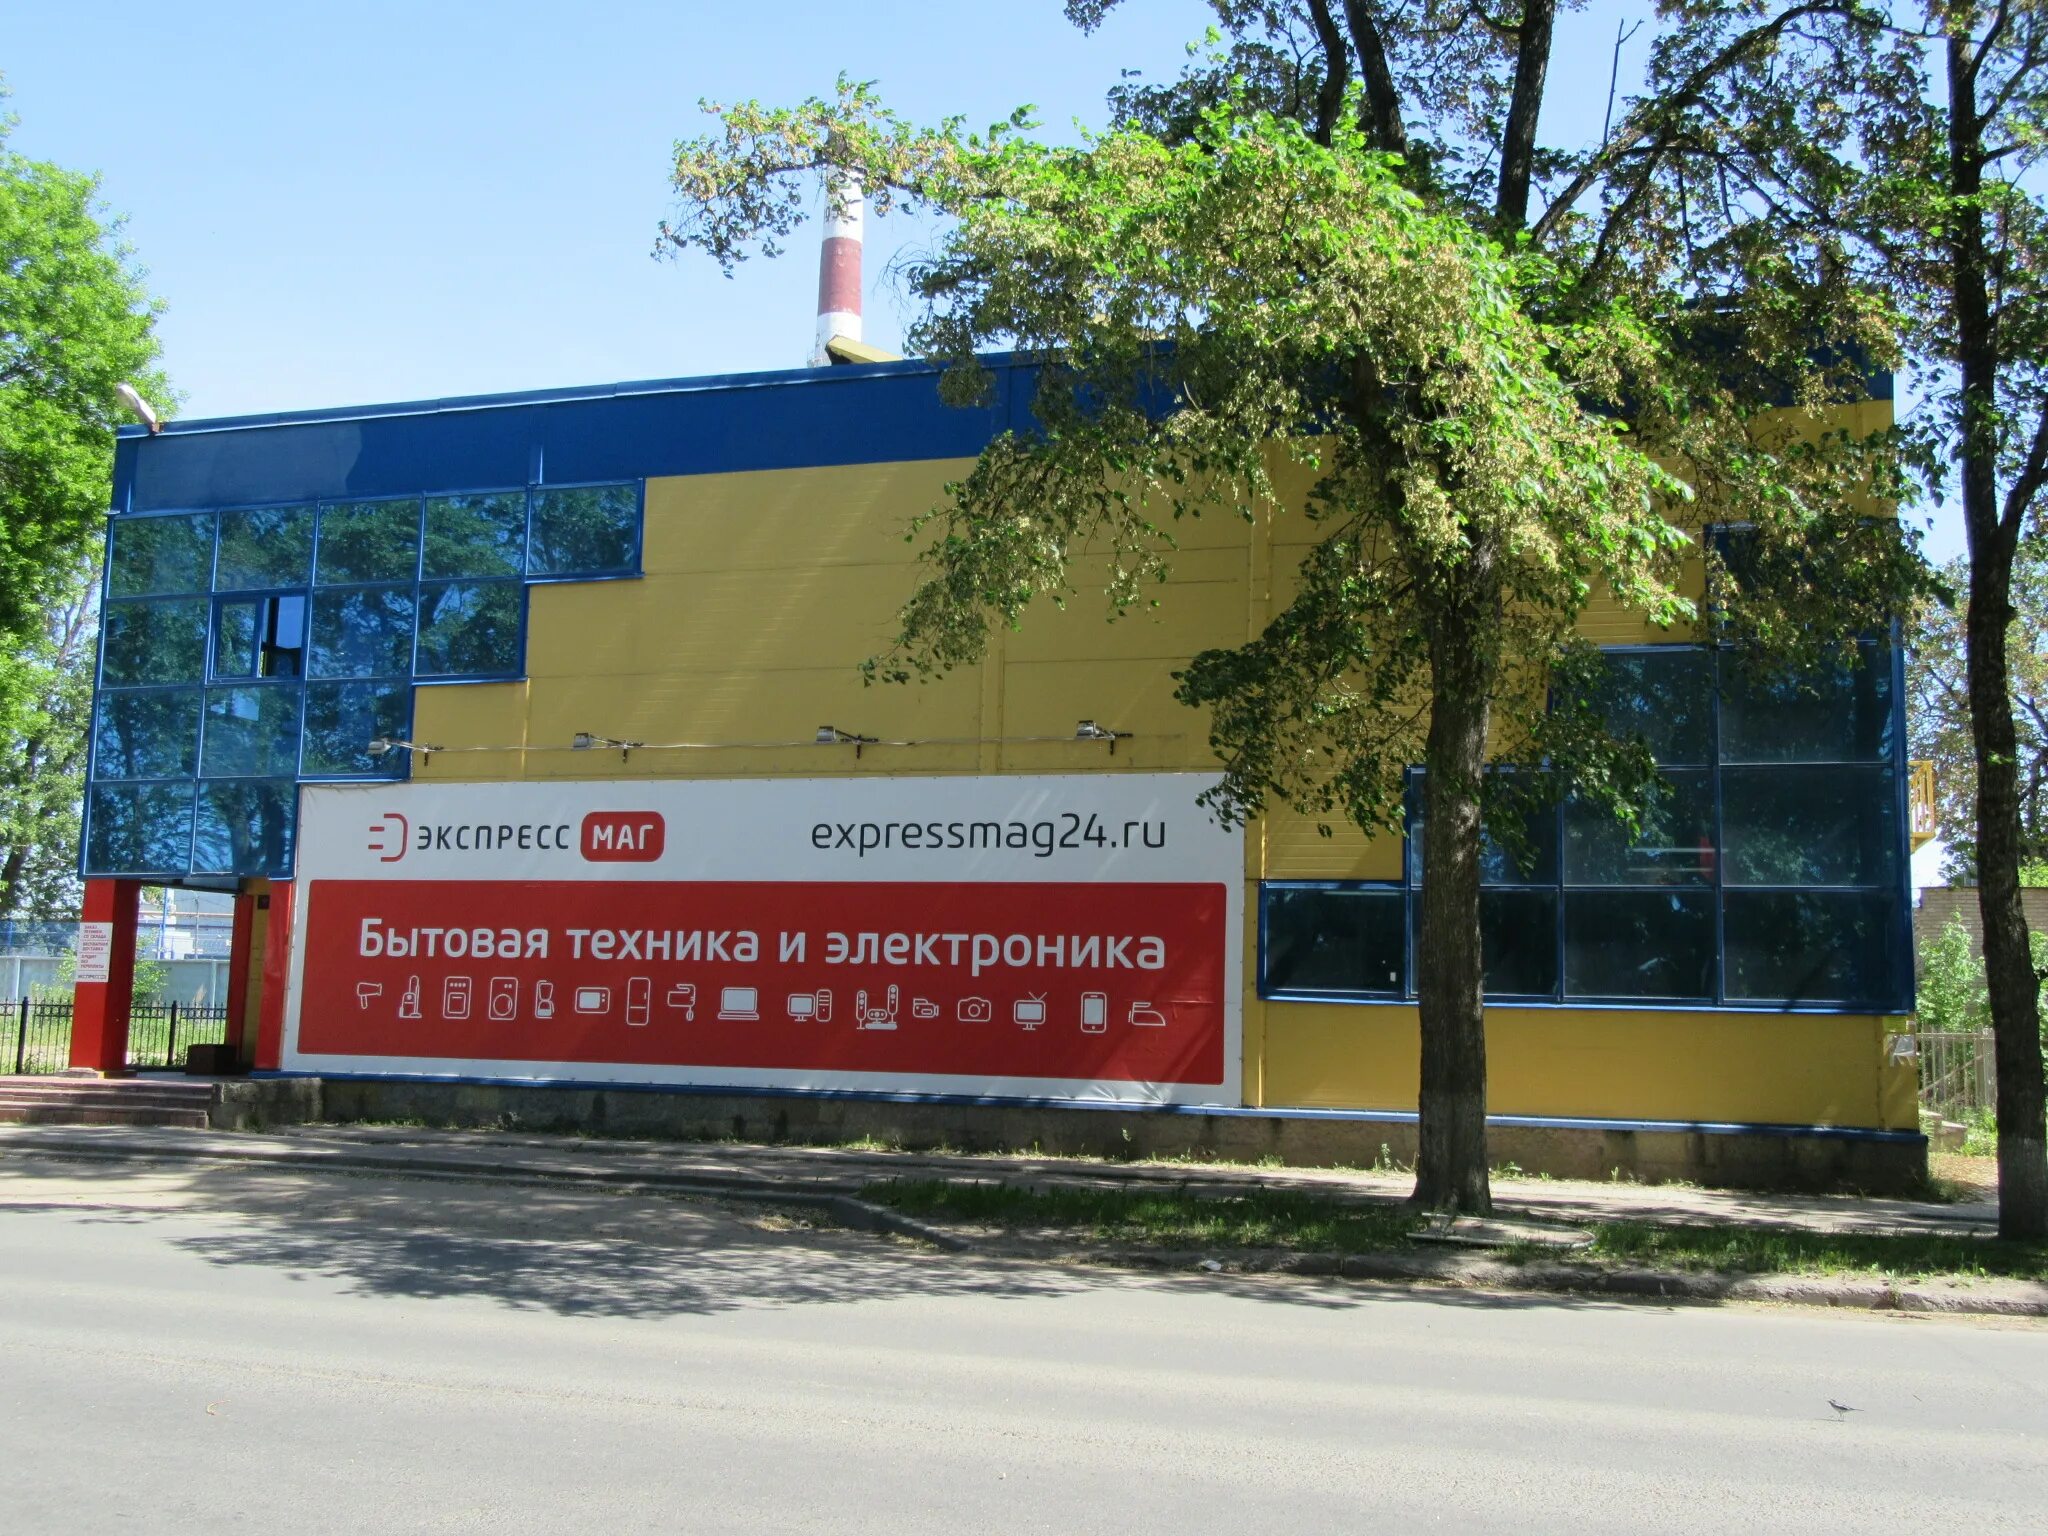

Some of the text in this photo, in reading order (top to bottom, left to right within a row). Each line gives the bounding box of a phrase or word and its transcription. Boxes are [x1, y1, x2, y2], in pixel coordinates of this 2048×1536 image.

[417, 823, 654, 850] ЭКСПРЕСС МАГ
[811, 812, 1166, 858] expressmag24.ru
[359, 917, 1165, 977] Бытовая техника и электроника
